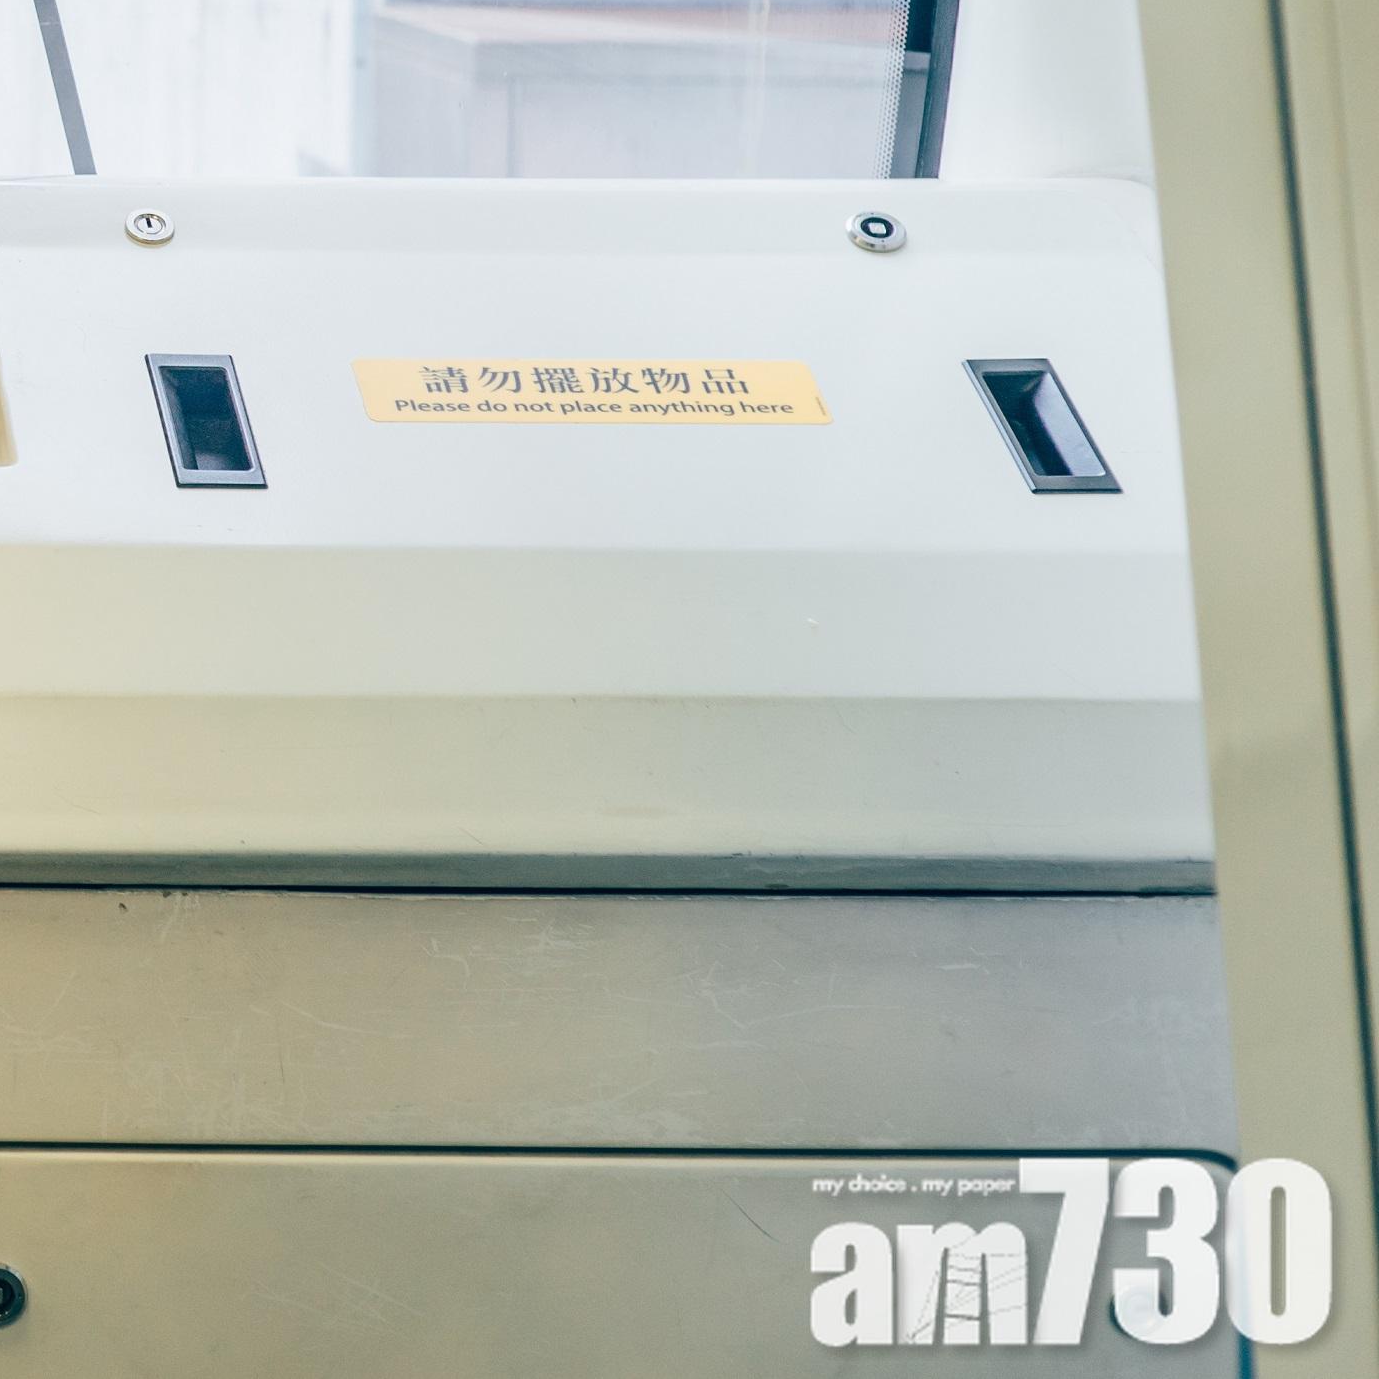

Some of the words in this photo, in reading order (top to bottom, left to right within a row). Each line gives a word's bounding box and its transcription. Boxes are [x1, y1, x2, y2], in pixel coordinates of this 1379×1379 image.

[419, 366, 749, 394] 請勿擺放物品
[395, 399, 471, 413] Please
[477, 399, 507, 413] do
[514, 401, 554, 413] not
[560, 400, 622, 416] place
[629, 401, 736, 417] anything
[739, 401, 794, 414] here
